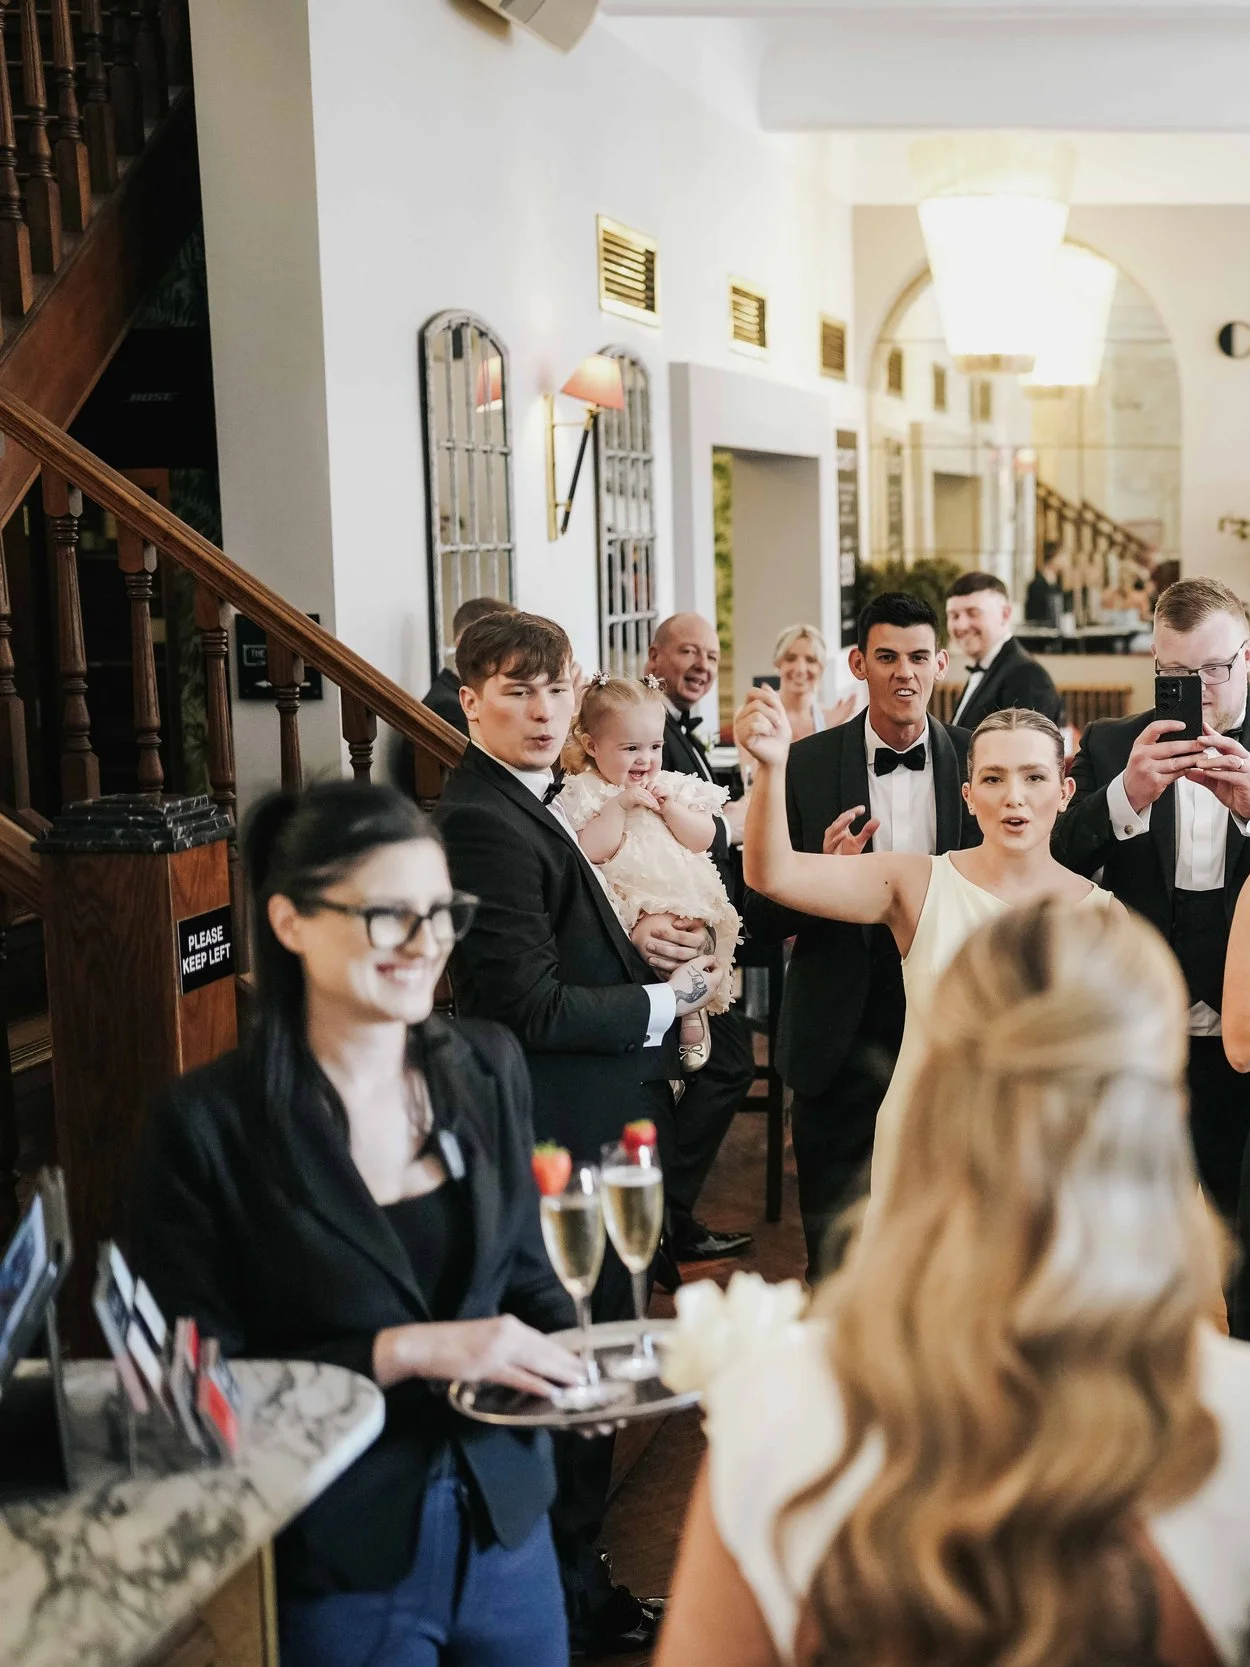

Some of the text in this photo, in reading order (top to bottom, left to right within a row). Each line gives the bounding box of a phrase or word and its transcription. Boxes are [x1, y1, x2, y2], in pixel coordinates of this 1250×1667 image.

[188, 925, 224, 952] PLEASE
[182, 943, 231, 975] KEEP LEFT
